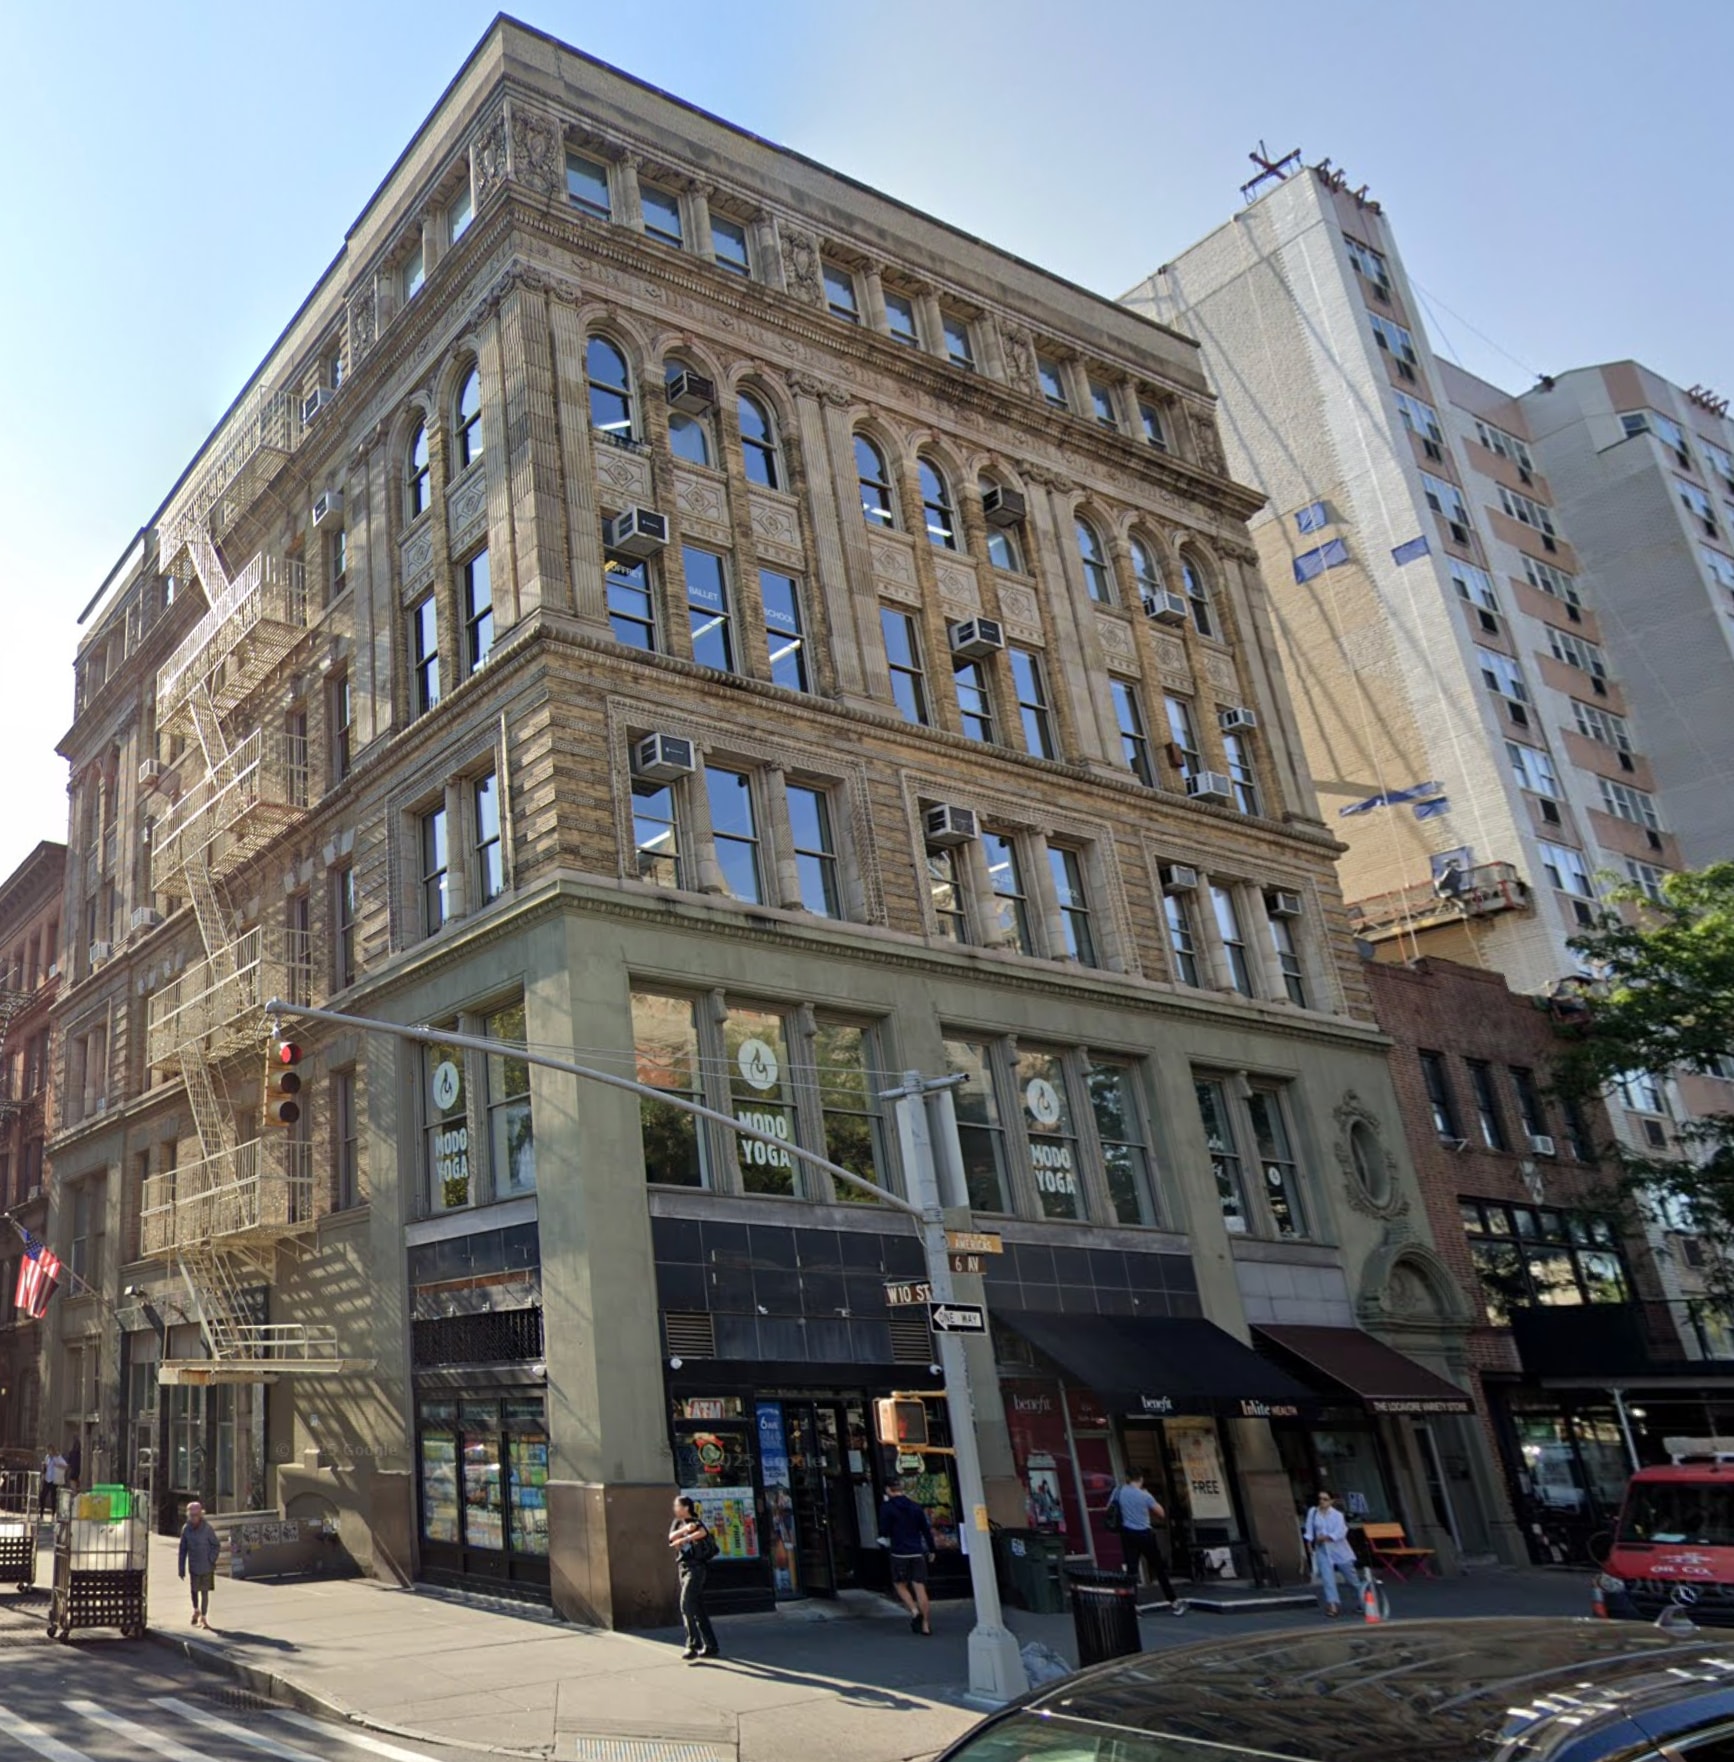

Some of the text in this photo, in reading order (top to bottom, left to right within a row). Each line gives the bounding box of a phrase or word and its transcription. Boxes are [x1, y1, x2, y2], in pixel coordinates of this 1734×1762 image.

[688, 585, 719, 602] BALLET
[764, 607, 795, 625] SCHOOL
[738, 1111, 788, 1140] MODO
[435, 1127, 468, 1158] MODO
[741, 1139, 792, 1168] YOGA
[1030, 1143, 1071, 1169] MODO
[436, 1154, 469, 1184] YOGA
[1035, 1169, 1077, 1194] YOGA
[955, 1255, 979, 1272] 6 AV
[916, 1283, 932, 1301] ST
[939, 1311, 978, 1324] ONE WAY
[692, 1401, 720, 1418] ATM
[1013, 1393, 1052, 1414] benefit
[1140, 1395, 1173, 1413] benefit
[1373, 1401, 1388, 1412] THE
[1191, 1480, 1220, 1495] FREE
